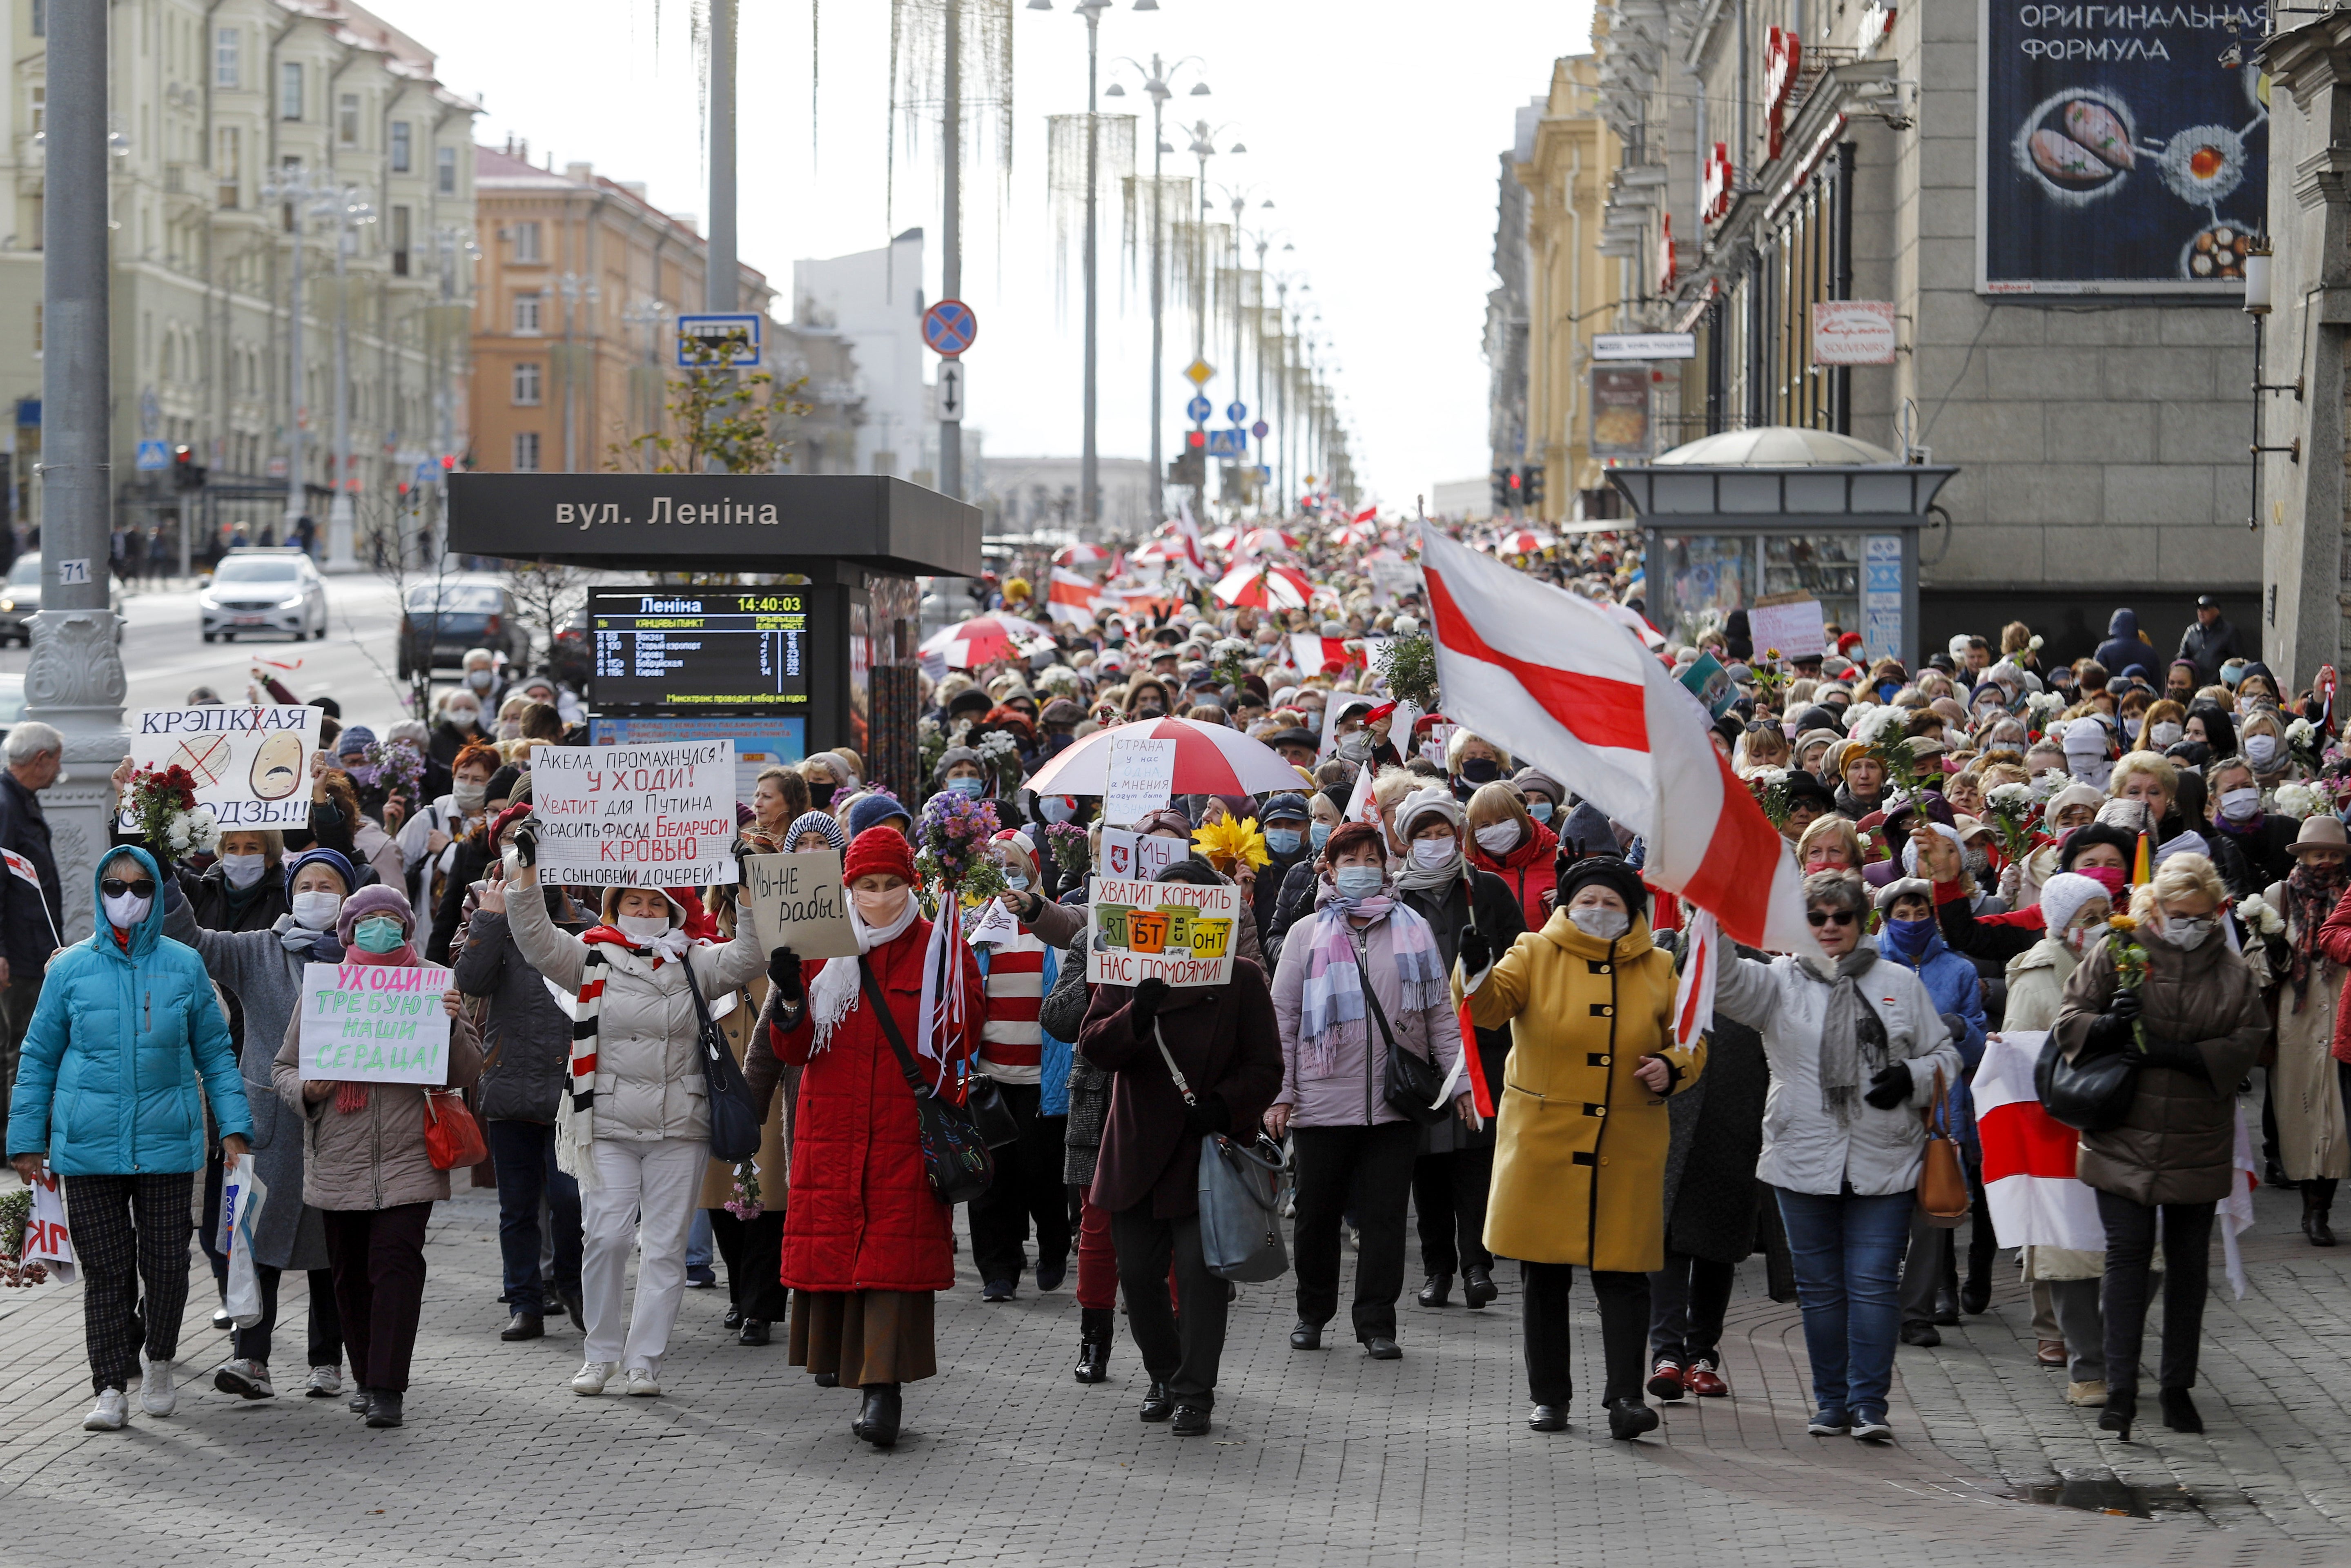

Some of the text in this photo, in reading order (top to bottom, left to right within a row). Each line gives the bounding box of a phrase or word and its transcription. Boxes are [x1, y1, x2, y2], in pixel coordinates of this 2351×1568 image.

[2020, 4, 2266, 29] ОРИГИНАЛЬНАЯ
[2021, 38, 2170, 61] ФОРМУЛА
[1824, 343, 1886, 353] SOUVENIRS
[556, 497, 778, 530] вул. Леніна
[65, 562, 84, 581] 71
[640, 597, 801, 612] Леніна 14:40:03
[635, 619, 676, 629] КАНЦАВЫ
[677, 619, 705, 628] ПУНКТ
[606, 641, 622, 650] 100
[635, 641, 666, 650] Старый
[666, 642, 702, 650] аэропорт
[760, 641, 768, 649] 4
[635, 633, 665, 641] Вокзал
[606, 650, 611, 659] 1
[635, 649, 665, 659] Кирова
[760, 649, 767, 658] 5
[787, 649, 799, 658] 23
[635, 668, 665, 677] Кирова
[666, 694, 713, 703] Минсктранс
[714, 695, 751, 703] проводит
[752, 693, 775, 703] набор
[1117, 740, 1164, 752] СТРАНА
[1122, 780, 1169, 790] МНЕНИЯ
[541, 822, 599, 838] КРАСИТЬ
[602, 822, 650, 840] ФАСАД
[601, 837, 697, 862] КРОВЬЮ
[539, 868, 557, 884] ЕЕ
[1099, 880, 1231, 909] ХВАТИТ КОРМИТЬ
[1107, 917, 1125, 940] RT
[1134, 924, 1163, 945] БТ
[1174, 917, 1184, 941] СТВ
[1193, 933, 1225, 949] ОНТ
[1101, 956, 1222, 984] НАС ПОМОЯМИ!
[316, 991, 442, 1016] ТРЕБУЮТ
[342, 1017, 417, 1040] НАШИ
[316, 1044, 439, 1075] СЕРДЦА!
